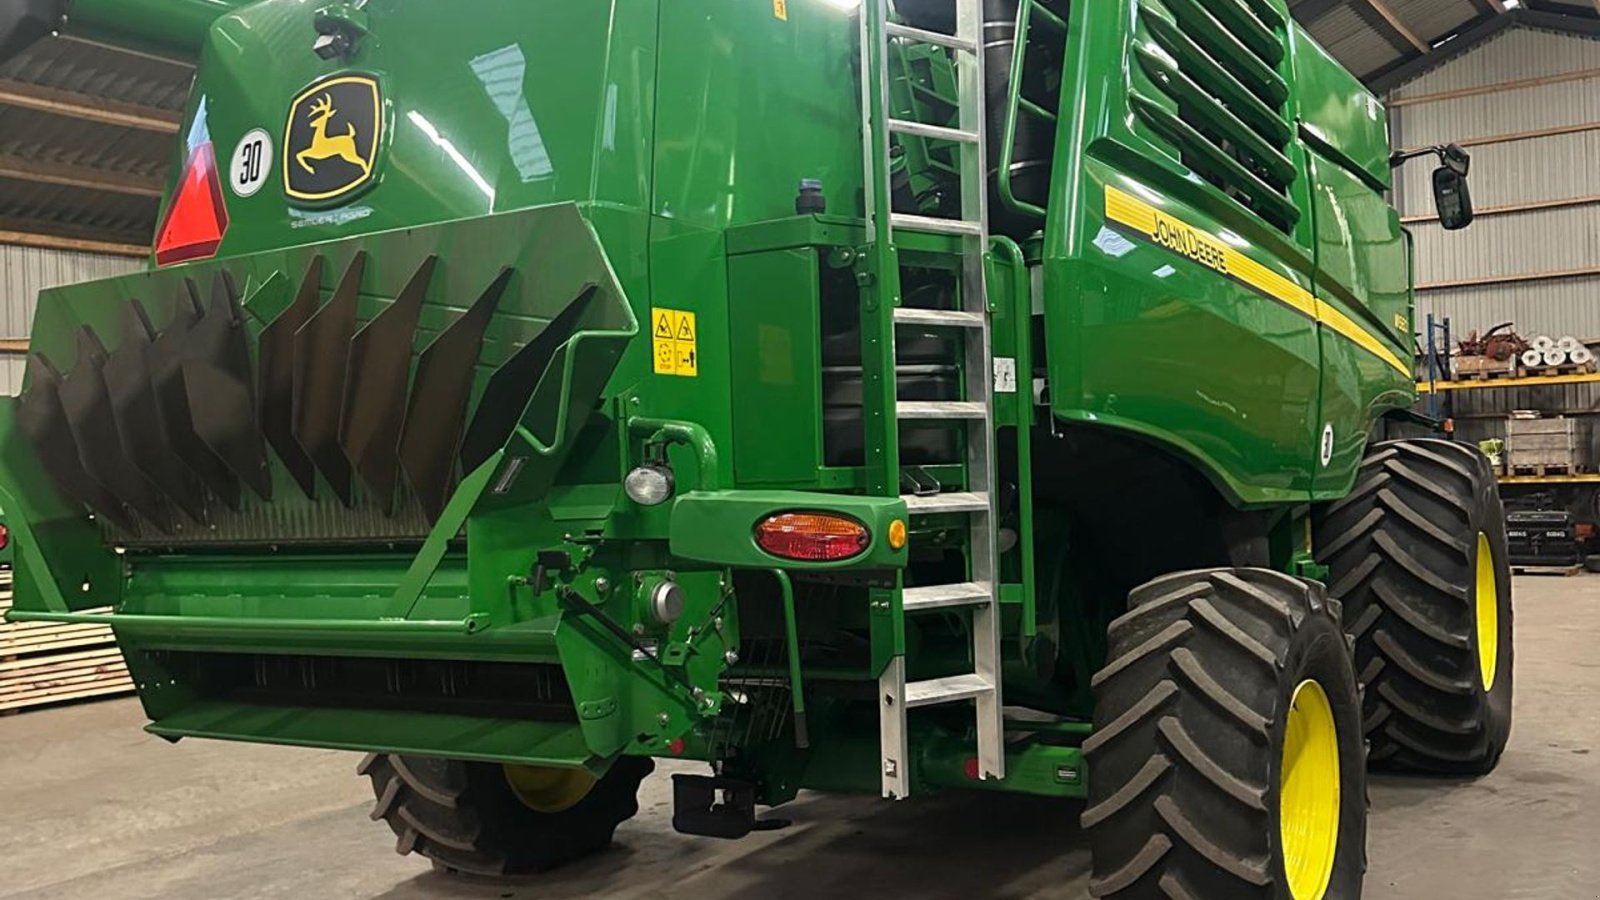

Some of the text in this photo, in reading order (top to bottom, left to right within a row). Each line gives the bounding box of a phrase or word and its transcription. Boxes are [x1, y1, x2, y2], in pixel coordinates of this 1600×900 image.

[240, 140, 262, 185] 30
[1153, 212, 1227, 272] JOHN DEERE
